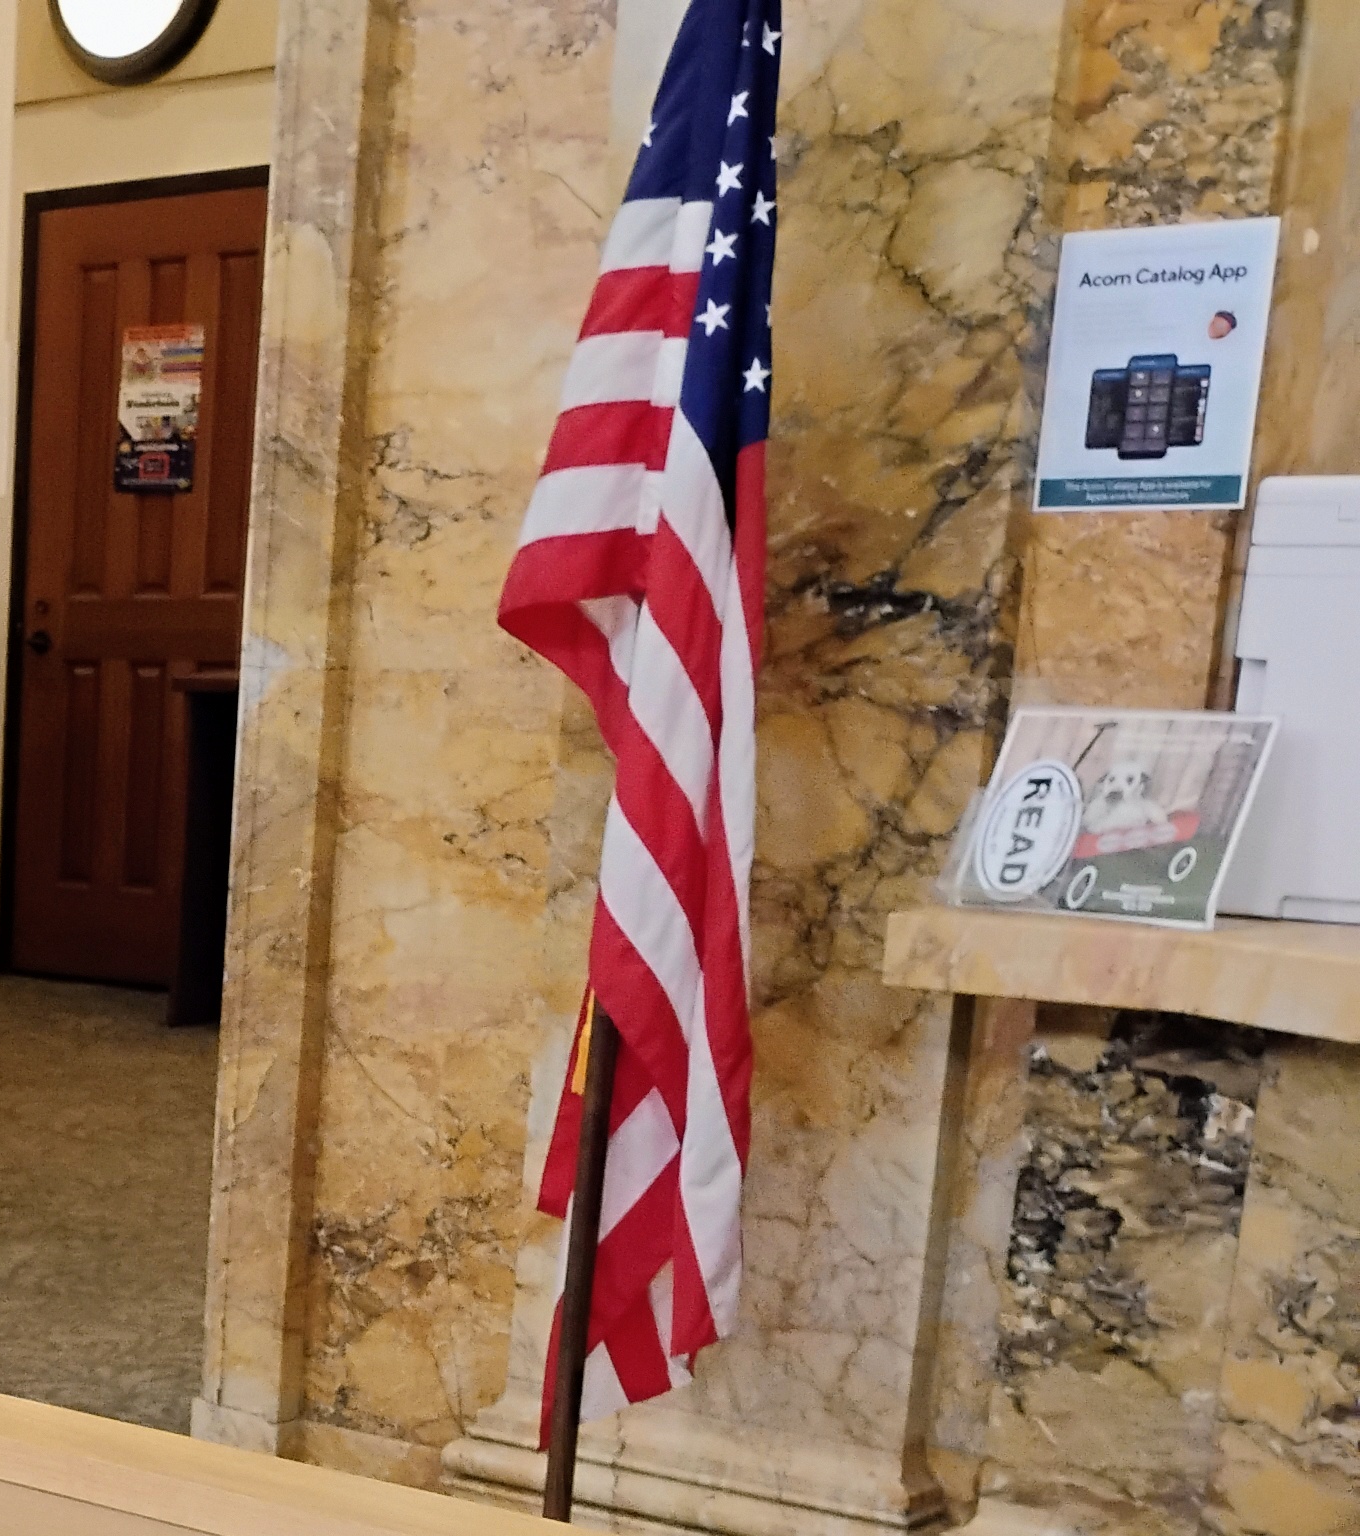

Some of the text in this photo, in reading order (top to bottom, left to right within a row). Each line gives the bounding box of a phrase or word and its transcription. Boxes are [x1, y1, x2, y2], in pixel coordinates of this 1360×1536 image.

[1079, 263, 1247, 288] Acorn Catalog App
[999, 776, 1052, 886] READ
